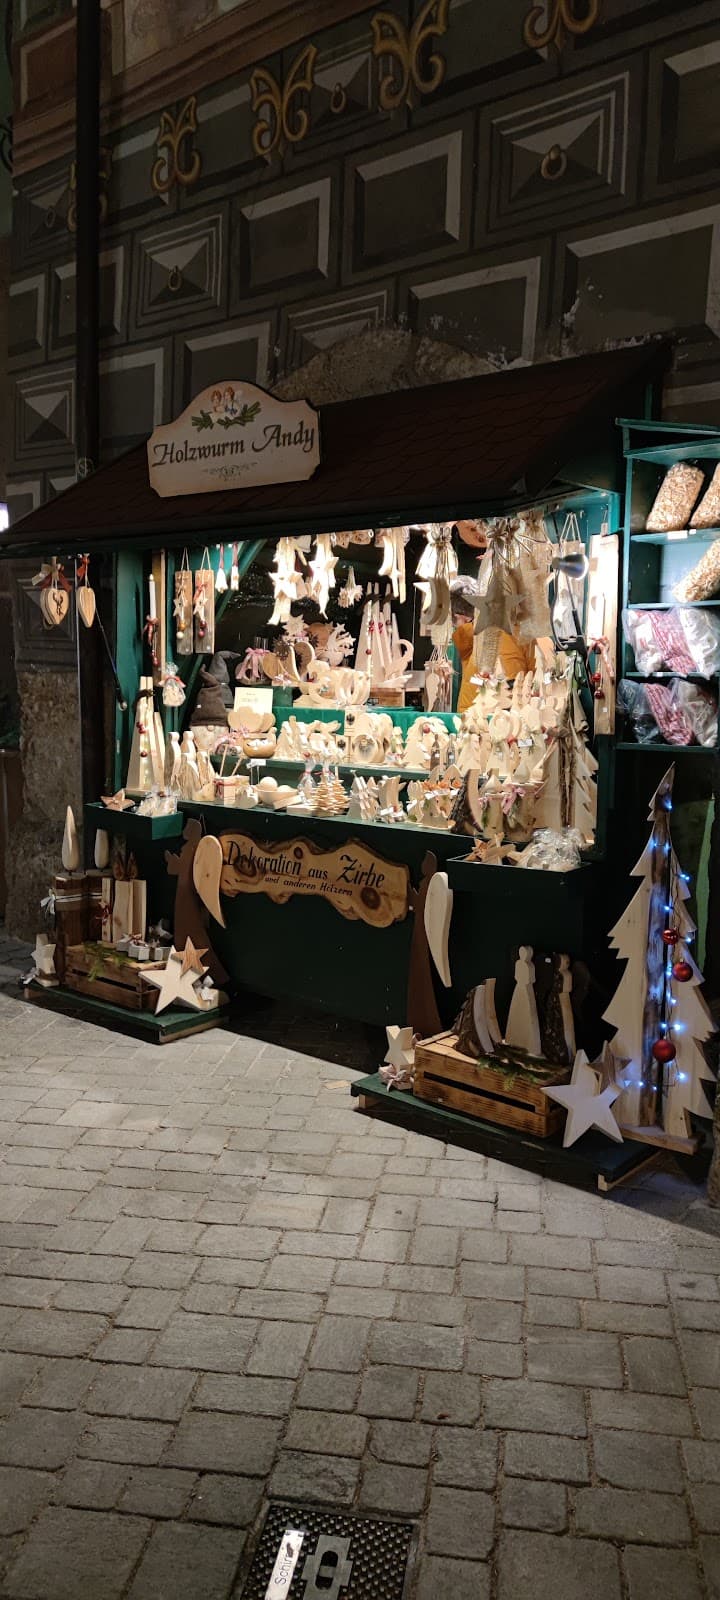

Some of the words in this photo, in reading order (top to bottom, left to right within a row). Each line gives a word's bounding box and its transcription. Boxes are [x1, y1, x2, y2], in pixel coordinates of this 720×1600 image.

[151, 439, 245, 467] Holzwurm
[251, 420, 315, 453] Andy
[226, 840, 302, 876] Dekoration
[307, 866, 329, 880] aus
[336, 854, 385, 887] Zirbe
[264, 875, 279, 884] und
[283, 877, 316, 890] anderen
